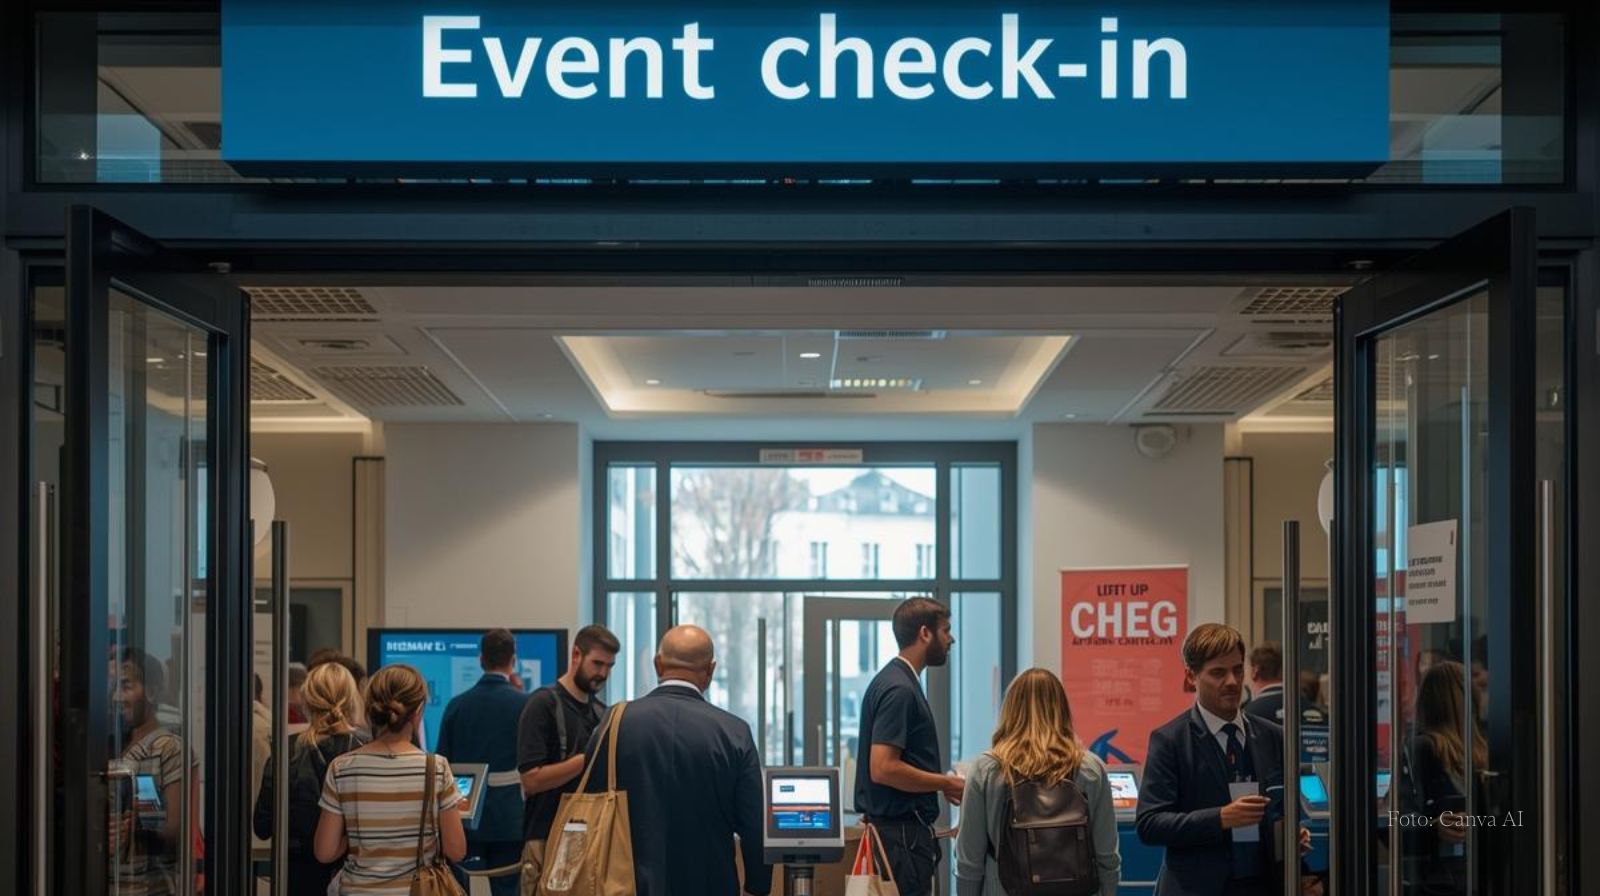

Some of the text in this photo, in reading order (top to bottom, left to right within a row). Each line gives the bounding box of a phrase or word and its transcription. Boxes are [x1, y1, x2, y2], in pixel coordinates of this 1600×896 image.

[422, 13, 1188, 100] Event check-in
[1130, 583, 1149, 596] UP
[1070, 600, 1178, 639] CHEG
